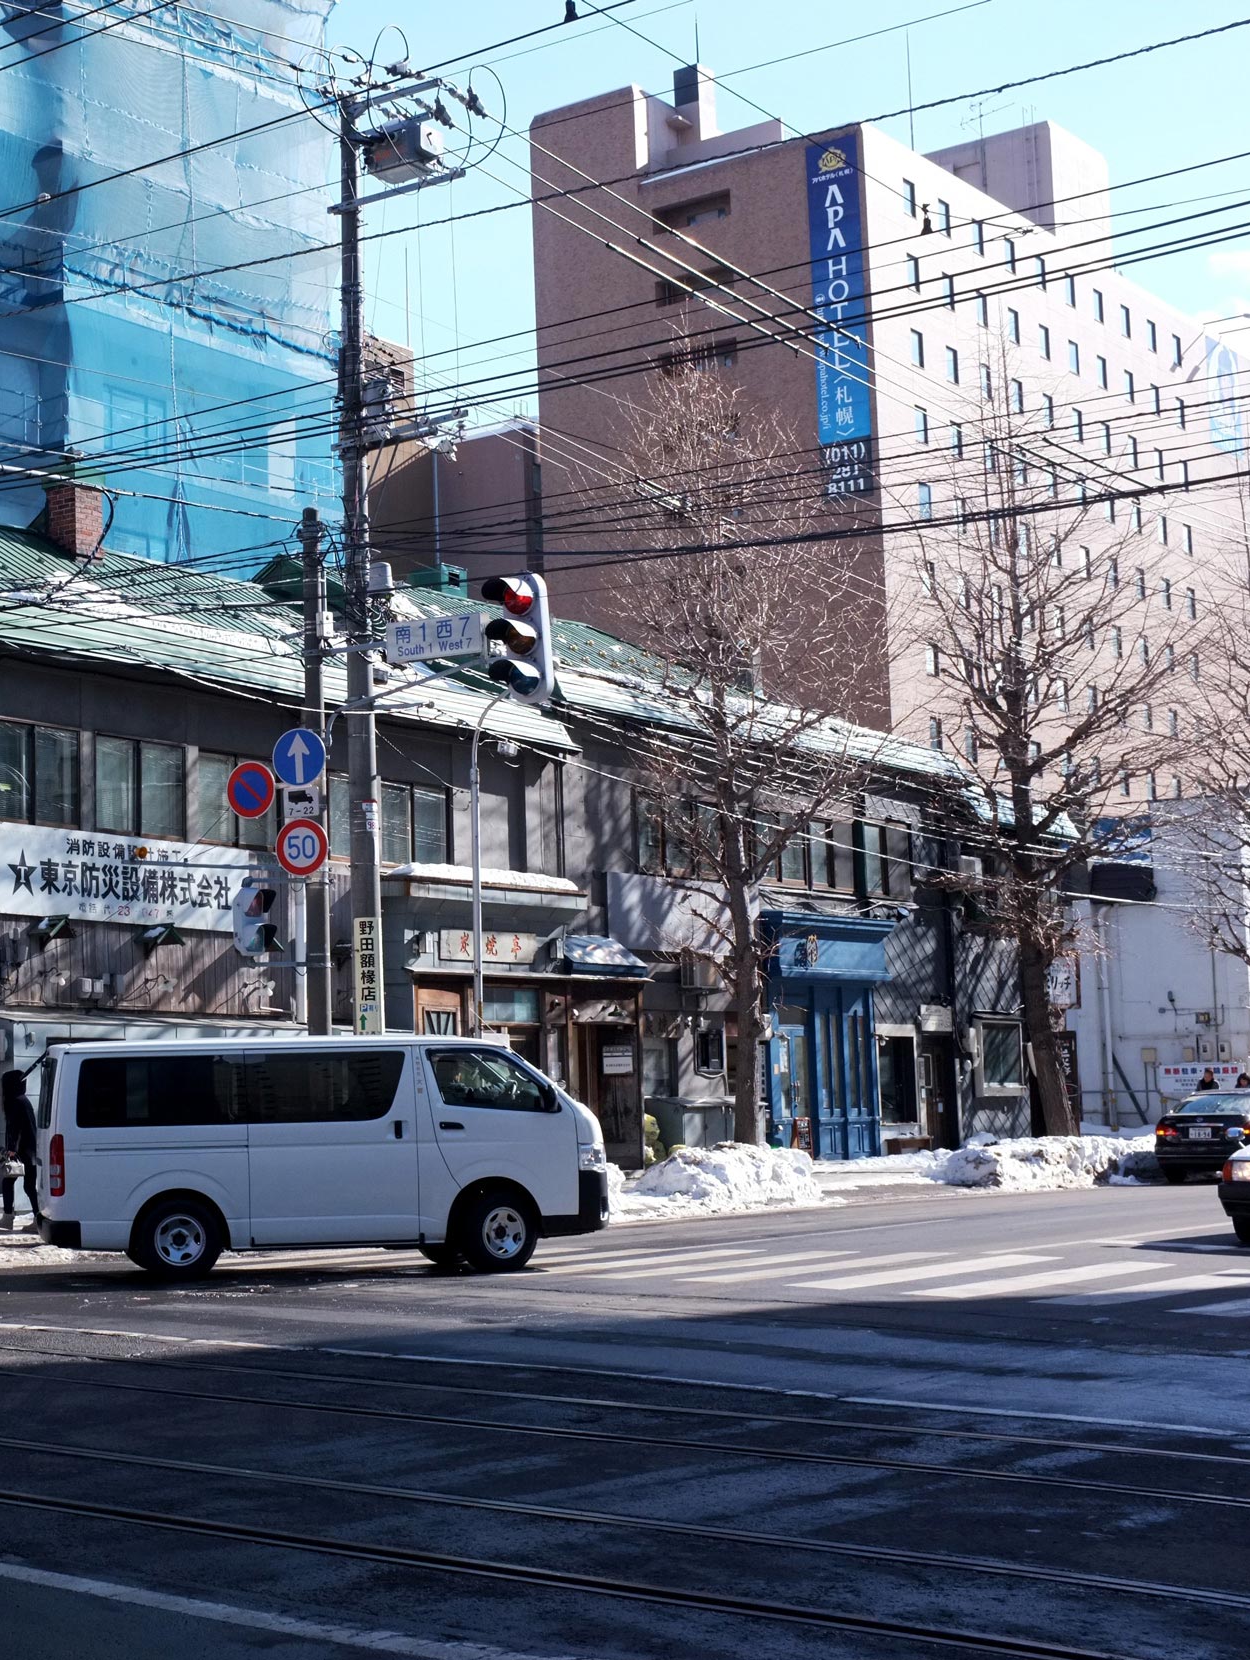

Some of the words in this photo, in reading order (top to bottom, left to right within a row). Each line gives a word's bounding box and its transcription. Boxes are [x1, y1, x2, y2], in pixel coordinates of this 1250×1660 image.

[824, 184, 847, 251] APA
[827, 256, 851, 369] HOTEL
[395, 616, 470, 644] 南1西7
[397, 644, 424, 656] South
[428, 643, 433, 653] 1
[439, 639, 463, 652] West
[466, 638, 472, 648] 7
[287, 834, 316, 860] 50
[39, 858, 232, 910] 東京防災設備株式会社
